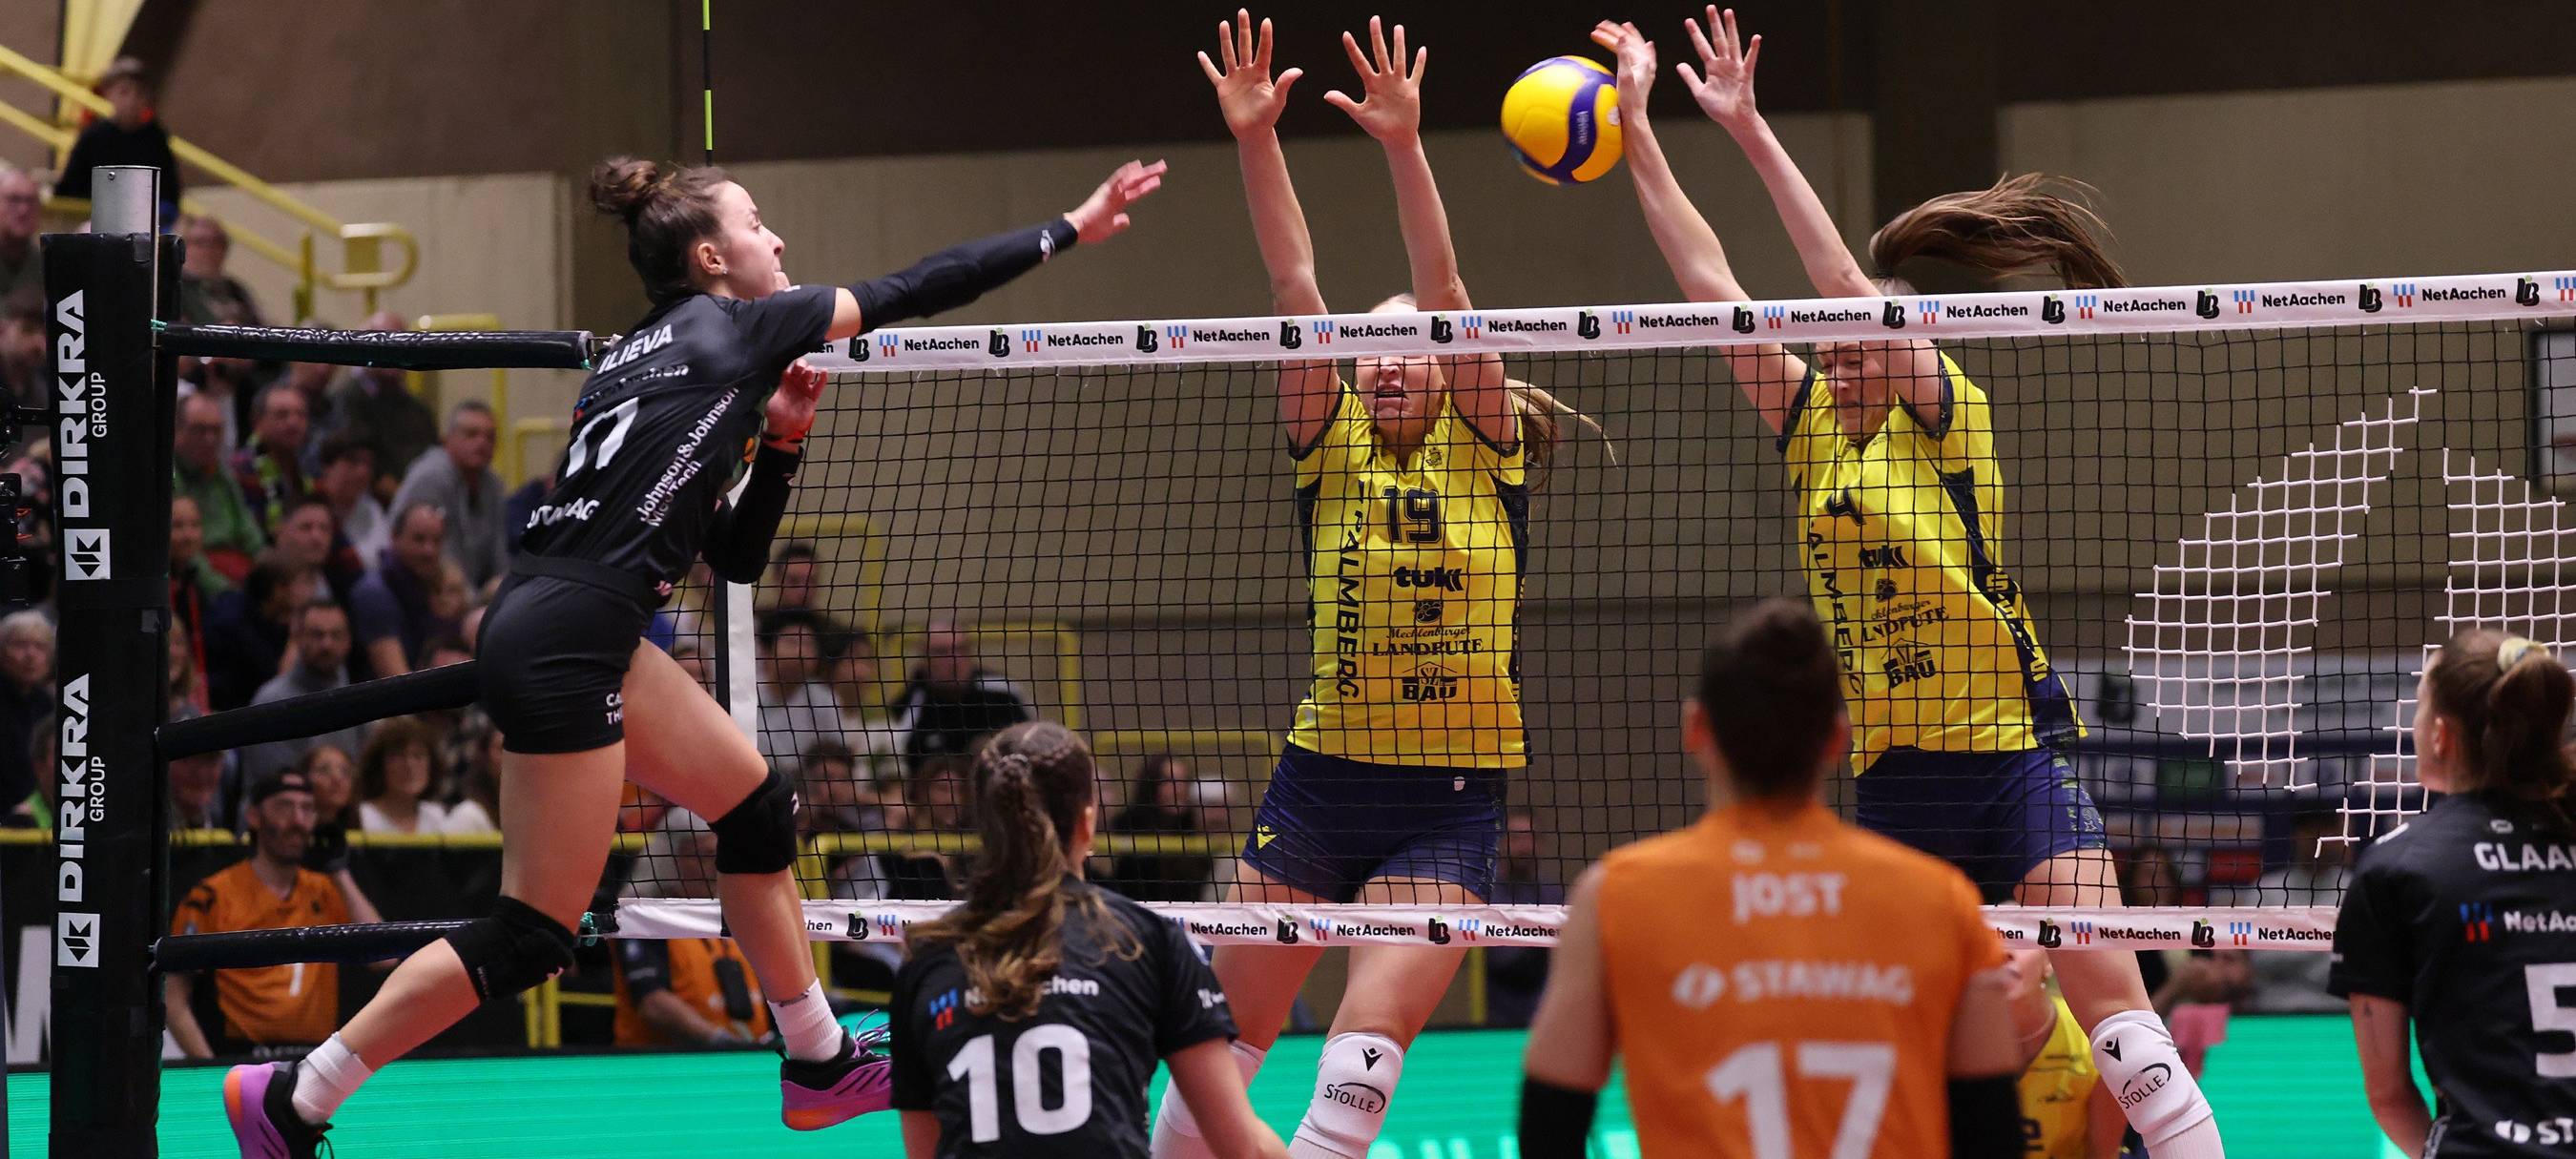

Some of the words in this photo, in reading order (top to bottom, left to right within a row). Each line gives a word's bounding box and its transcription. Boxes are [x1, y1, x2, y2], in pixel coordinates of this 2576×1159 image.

[904, 337, 980, 351] NetAachen
[1047, 333, 1124, 347] NetAachen
[1193, 328, 1270, 342] NetAachen
[1340, 323, 1418, 339] NetAachen
[1487, 319, 1568, 333] NetAachen
[1639, 314, 1719, 328] NetAachen
[1791, 309, 1872, 323] NetAachen
[1946, 303, 2028, 319] NetAachen
[2104, 298, 2187, 313] NetAachen
[2262, 292, 2345, 308] NetAachen
[2421, 286, 2506, 301] NetAachen
[596, 323, 674, 375] ILIEVA
[55, 289, 91, 518] DIRKRA
[91, 371, 108, 438] GROUP
[1383, 486, 1443, 544] 19
[1402, 684, 1458, 702] BAU
[57, 673, 91, 902] DIRKRA
[89, 755, 107, 822] GROUP
[1731, 872, 1847, 924] JOST
[1190, 922, 1267, 936] NetAachen
[1336, 923, 1416, 937] NetAachen
[2098, 927, 2181, 941] NetAachen
[1735, 960, 1914, 1004] STAWAG
[946, 1023, 1093, 1144] 10
[1323, 1084, 1377, 1114] STOLLE
[1706, 1042, 1897, 1159] 17
[2118, 1075, 2166, 1110] STOLLE
